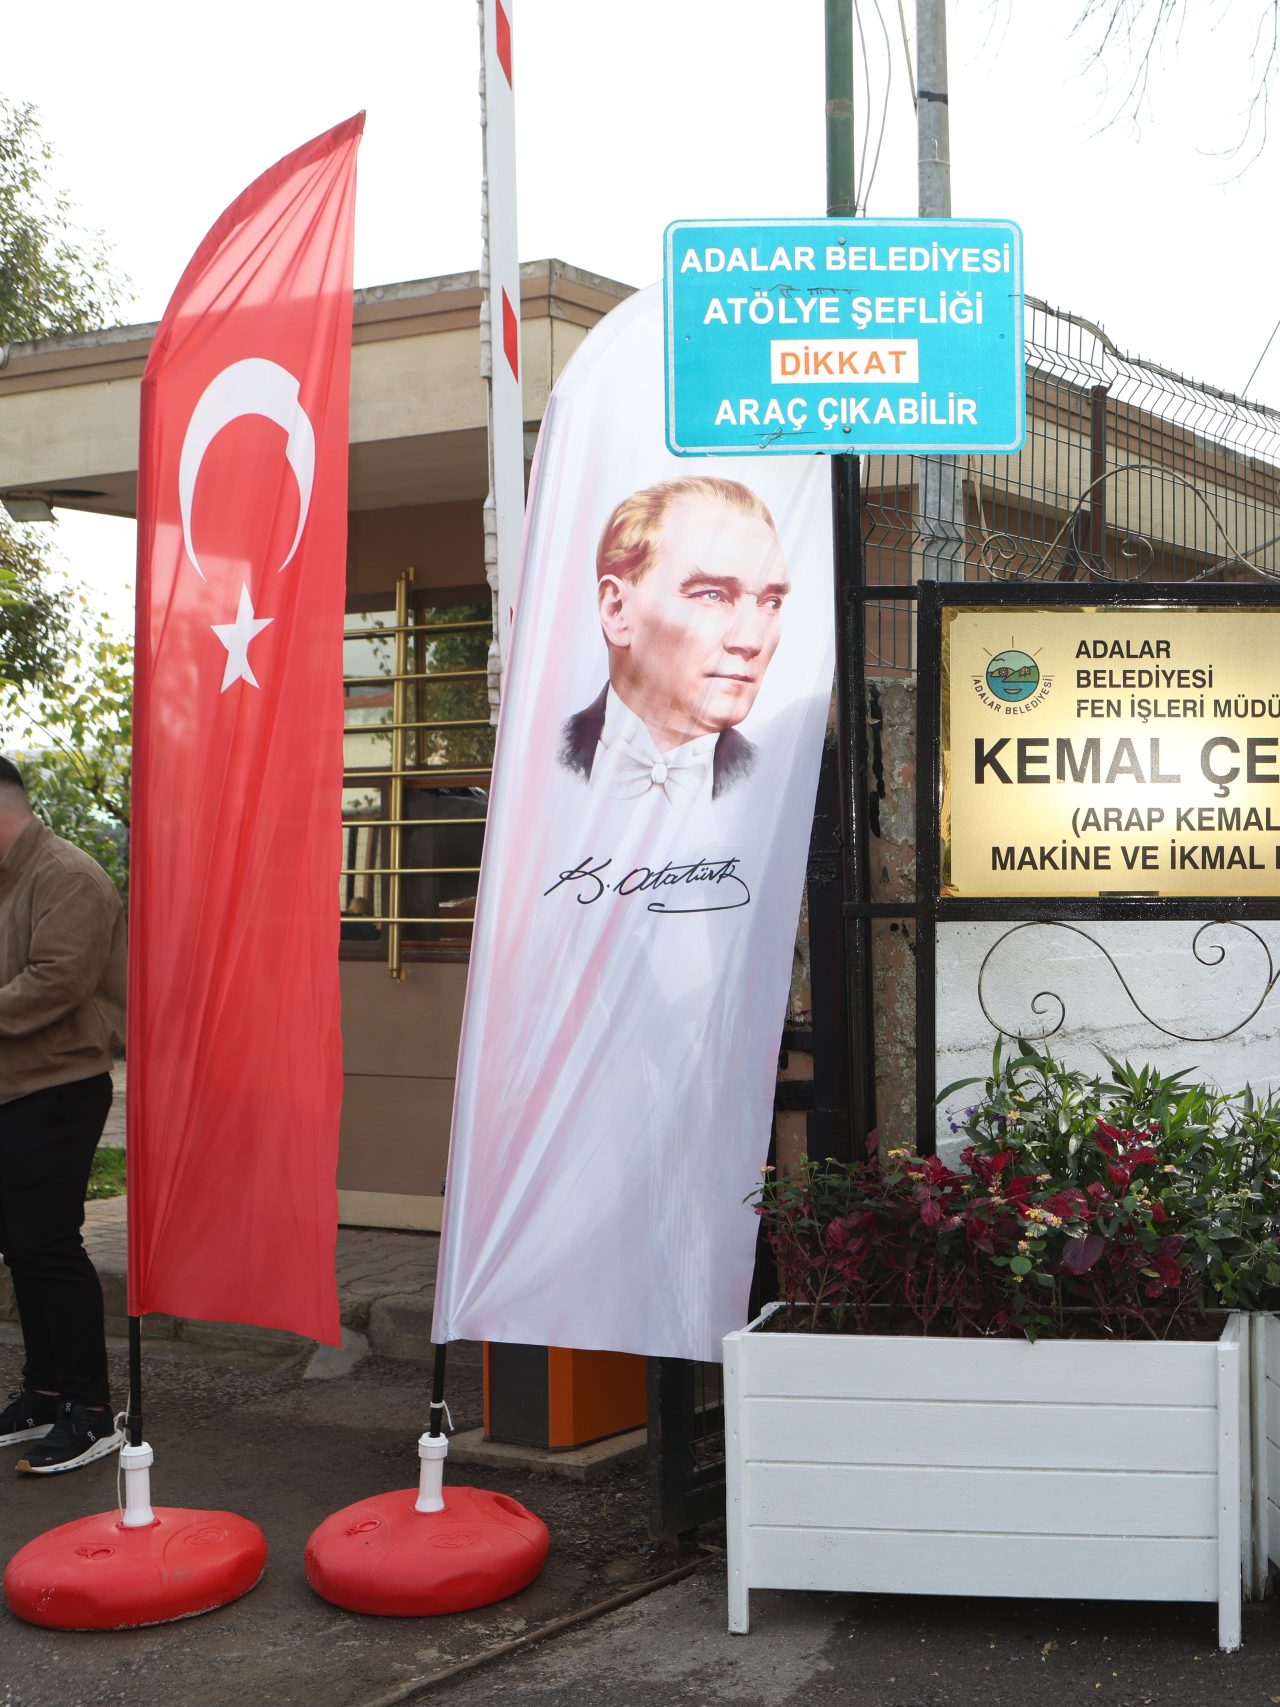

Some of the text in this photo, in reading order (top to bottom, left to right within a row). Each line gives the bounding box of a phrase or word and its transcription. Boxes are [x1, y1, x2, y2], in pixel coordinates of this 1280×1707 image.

[680, 241, 1010, 273] ADALAR BELEDİYESİ
[703, 290, 983, 330] ATÖLYE ŞEFLİĞİ
[780, 346, 907, 376] DİKKAT
[714, 391, 978, 431] ARAÇ ÇIKABİLİR
[1075, 639, 1171, 659] ADALAR
[1076, 664, 1213, 689] BELEDİYESİ
[973, 678, 1053, 715] ADALAR BELEDİYESİ
[1076, 699, 1122, 718] FEN
[1130, 693, 1205, 723] İŞLERİ
[974, 737, 1182, 785] KEMAL
[1072, 807, 1164, 838] (ARAP
[991, 839, 1112, 871] MAKİNE
[1120, 845, 1160, 870] VE
[1169, 838, 1266, 870] İKMAL
